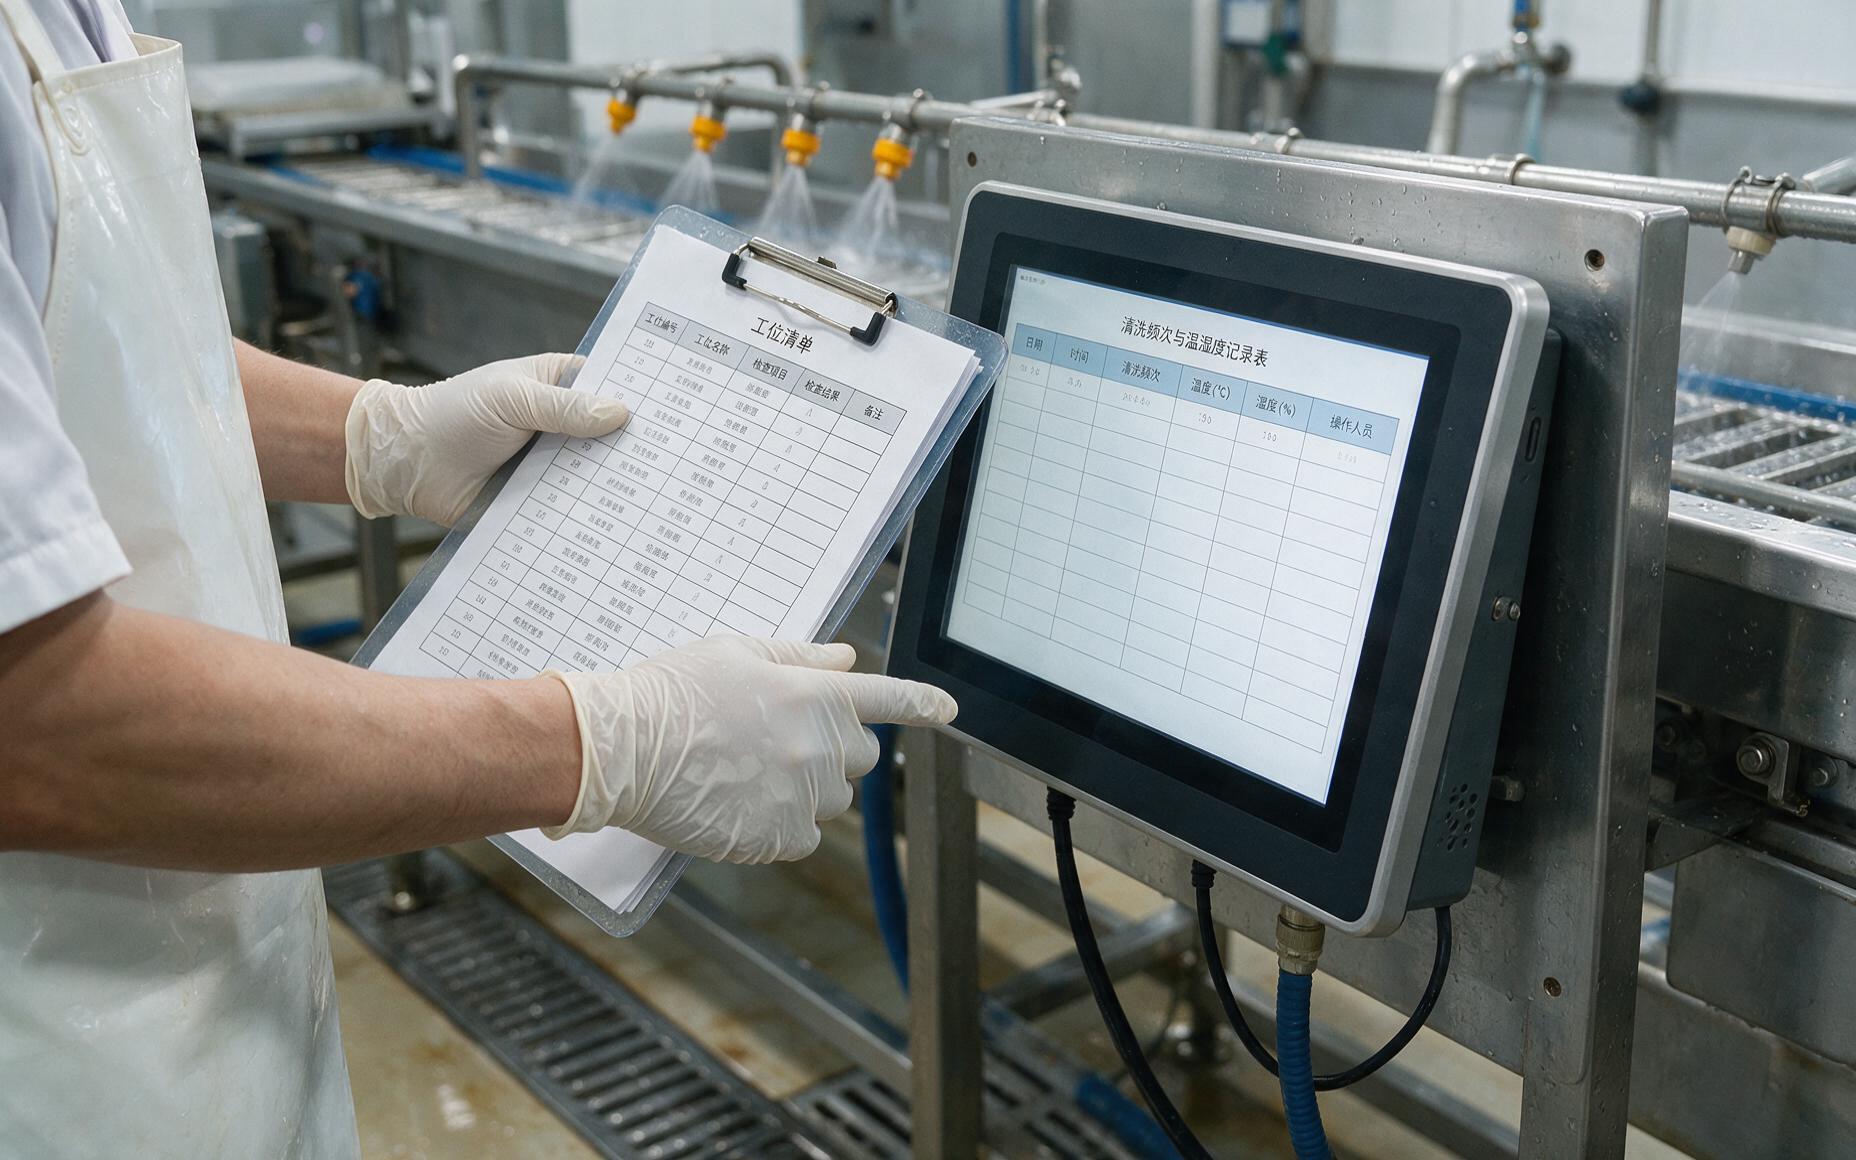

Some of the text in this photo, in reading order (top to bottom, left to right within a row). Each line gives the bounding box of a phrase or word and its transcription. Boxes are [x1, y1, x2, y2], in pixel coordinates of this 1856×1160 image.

[750, 316, 814, 355] 工位清单
[1120, 316, 1269, 367] 清洗频次与温湿度记录表
[1070, 348, 1089, 364] 时间
[1121, 360, 1161, 383] 清洗频次
[1330, 413, 1373, 439] 操作人员
